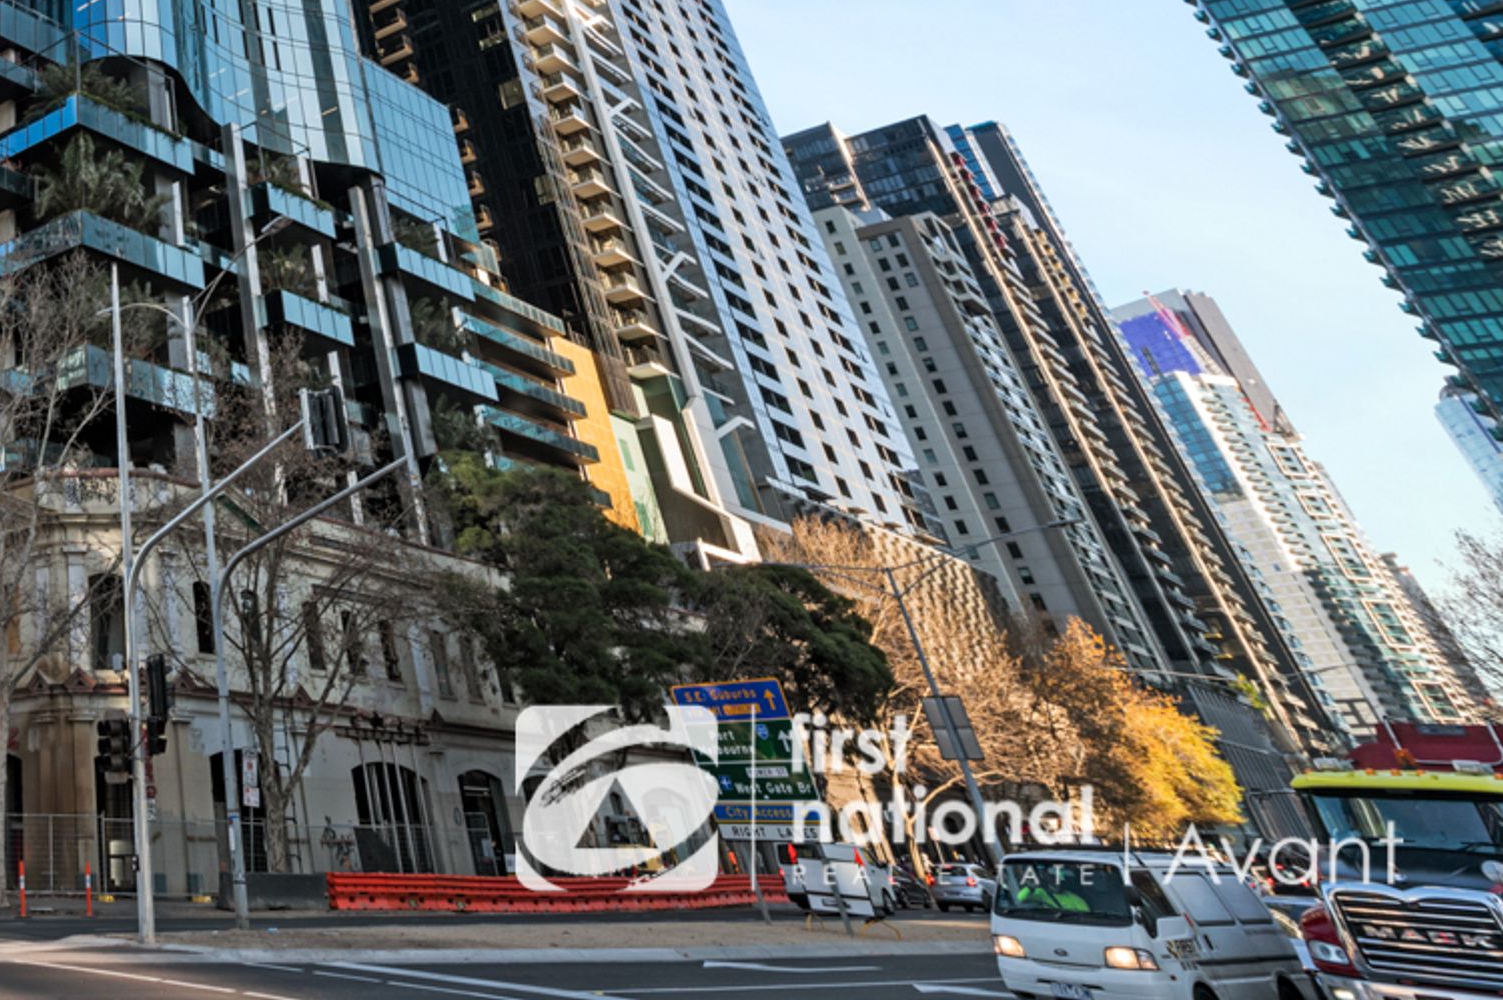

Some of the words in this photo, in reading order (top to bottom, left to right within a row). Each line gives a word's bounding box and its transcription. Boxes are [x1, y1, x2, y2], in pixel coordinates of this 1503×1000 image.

[708, 688, 757, 701] Suburbs
[734, 782, 761, 794] West
[765, 781, 793, 794] Gate
[797, 781, 811, 793] Br
[724, 806, 748, 821] City
[753, 804, 793, 818] Access
[731, 826, 766, 839] RIGHT
[777, 825, 818, 839] LAES
[1361, 924, 1496, 949] MACK
